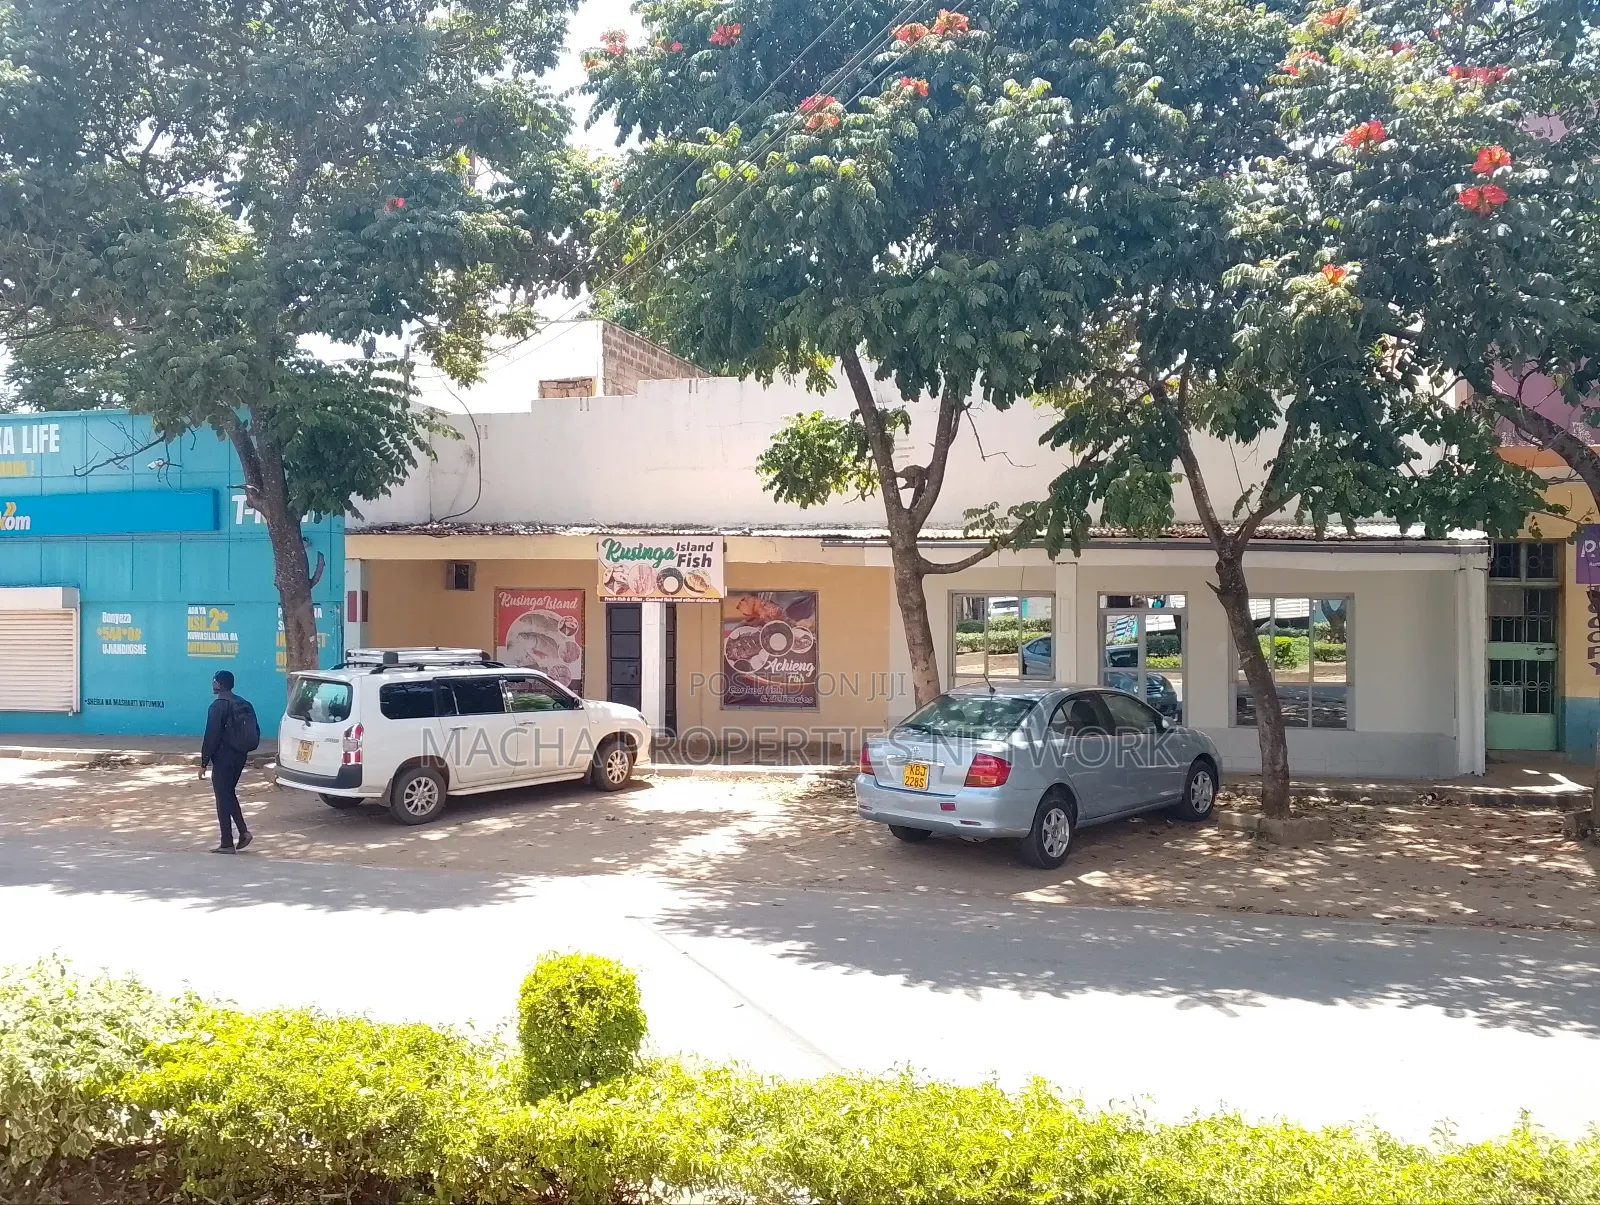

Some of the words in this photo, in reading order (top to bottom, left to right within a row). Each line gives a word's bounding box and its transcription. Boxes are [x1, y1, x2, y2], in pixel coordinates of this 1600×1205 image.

[22, 423, 60, 454] LIFE
[602, 538, 678, 569] Rusinga
[676, 541, 714, 552] Island
[677, 552, 712, 568] Fish
[499, 591, 544, 611] Rusinga
[543, 595, 578, 610] Island
[102, 612, 132, 625] Bonyeza
[764, 658, 815, 677] Achieng
[769, 695, 814, 704] delicacies
[908, 764, 928, 776] KBJ
